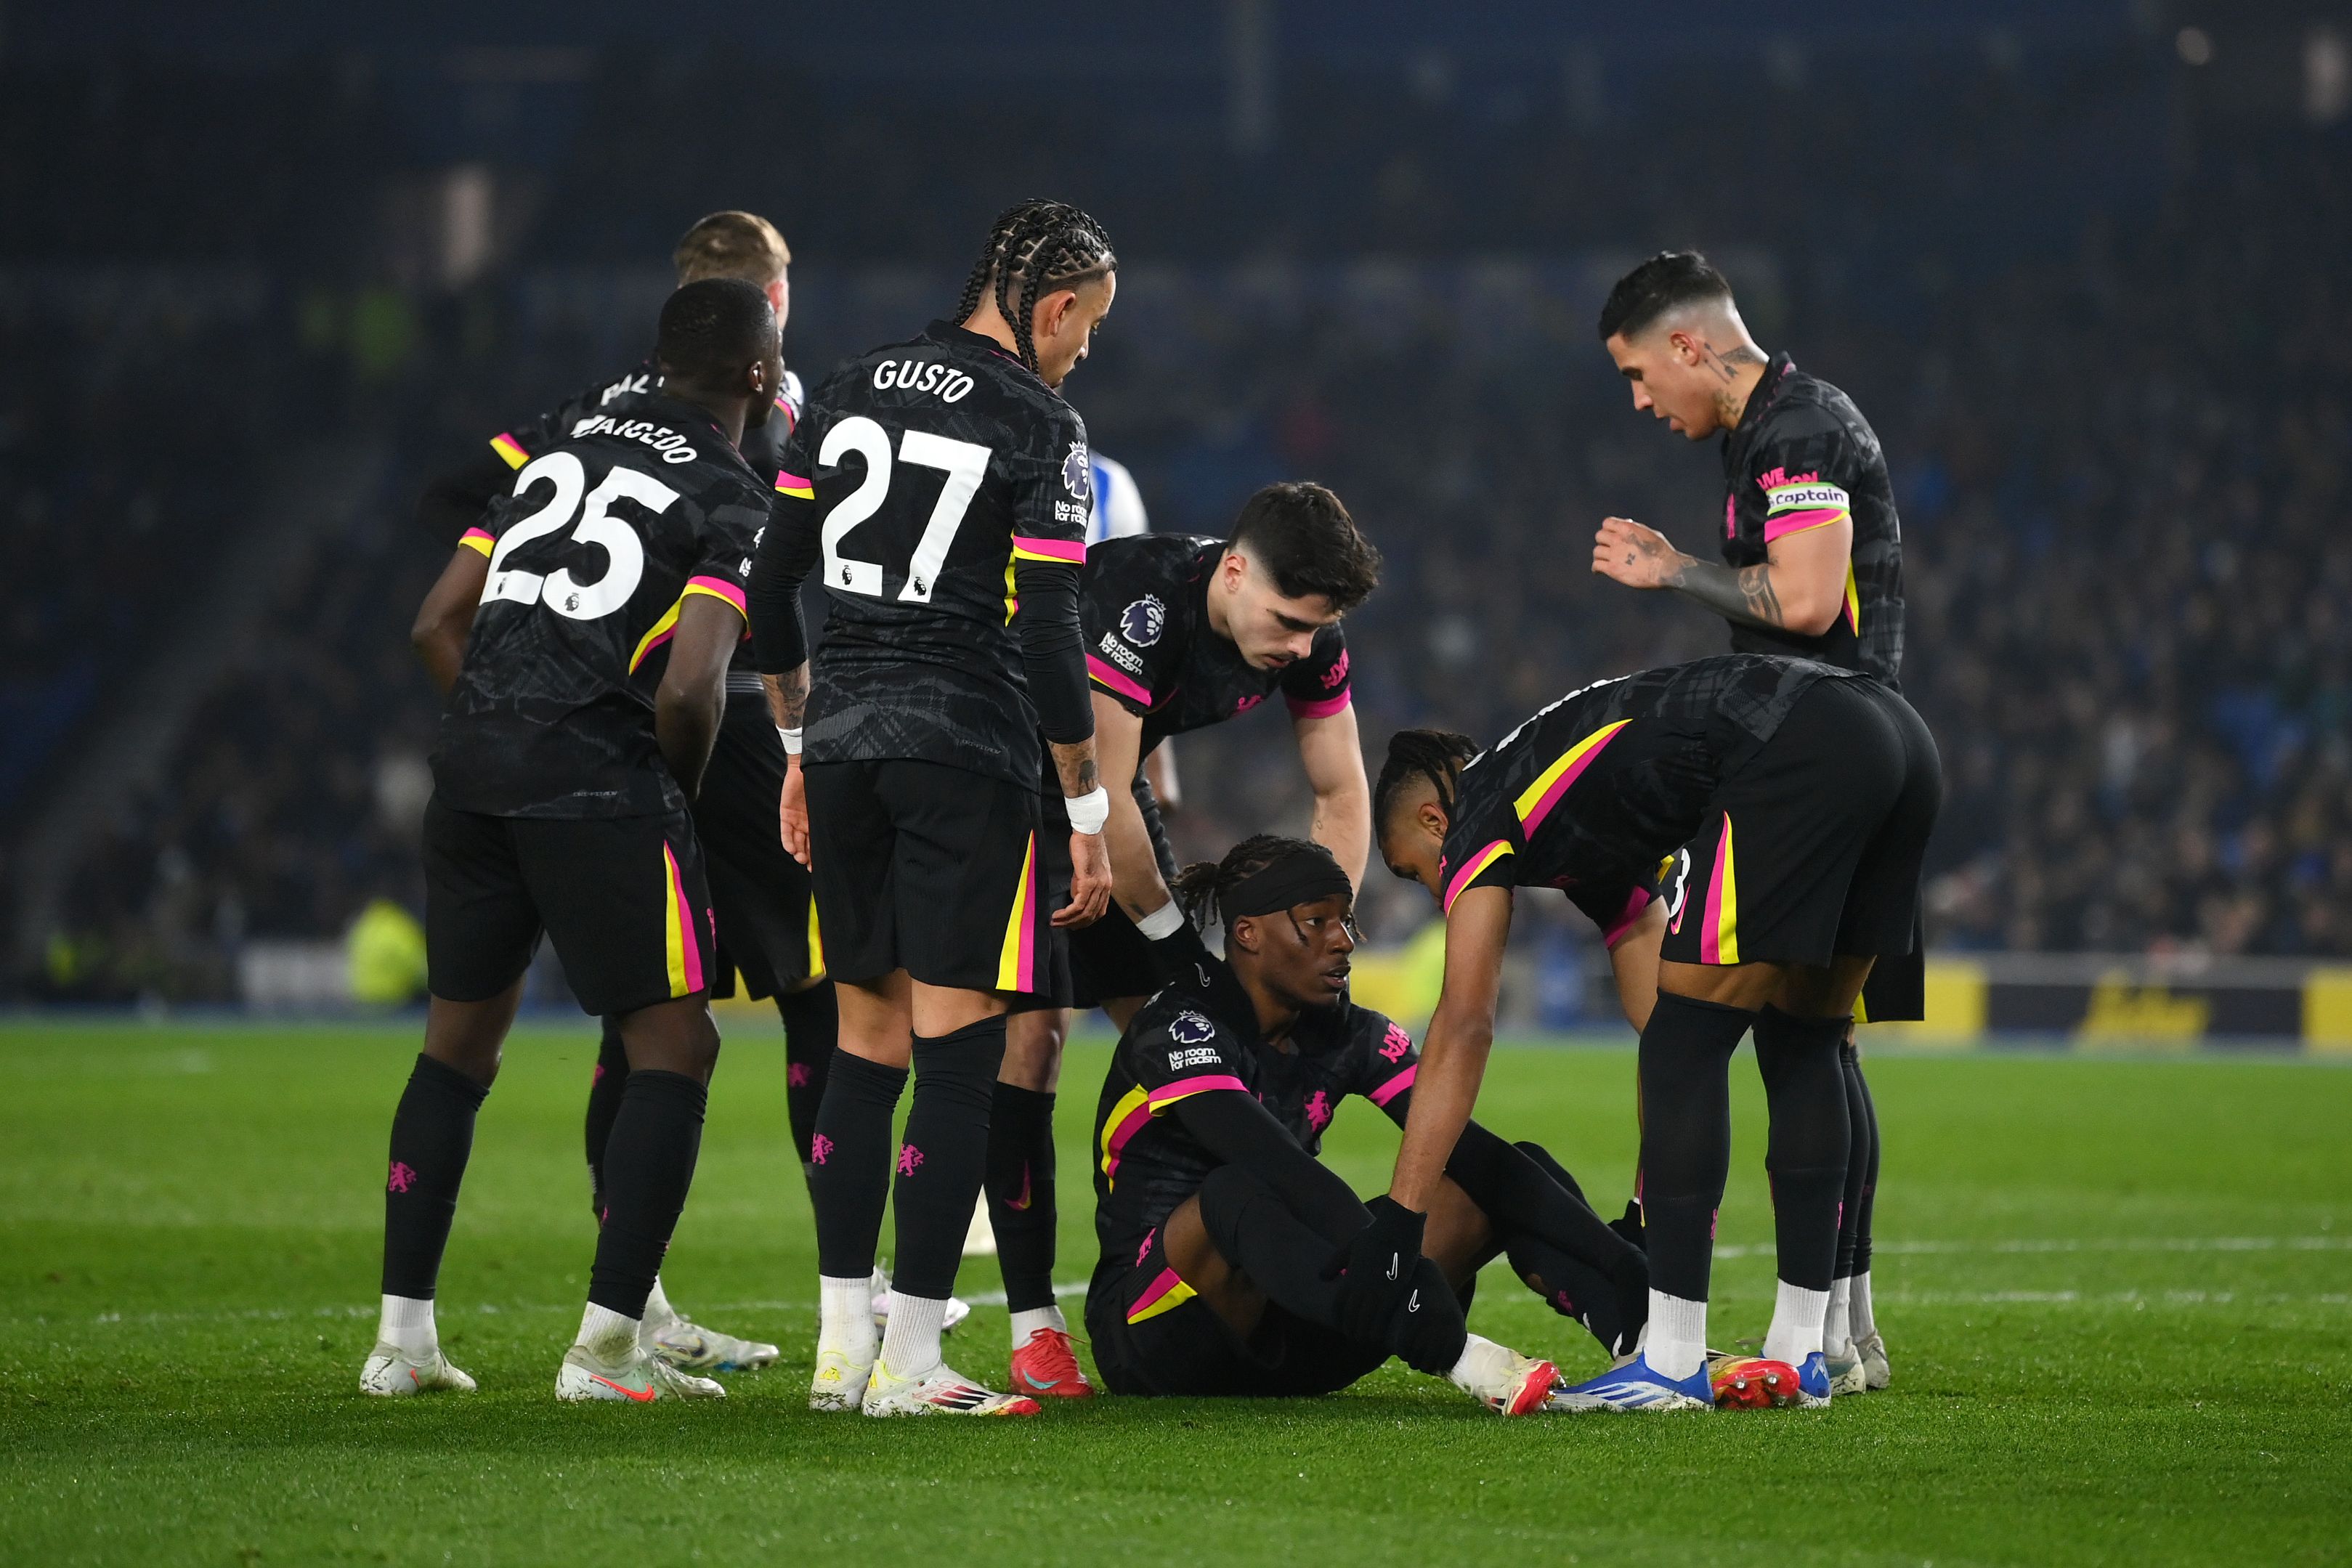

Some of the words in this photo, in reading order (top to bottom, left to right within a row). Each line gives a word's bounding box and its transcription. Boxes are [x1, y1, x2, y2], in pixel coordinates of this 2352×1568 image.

[873, 359, 974, 403] GUSTO
[818, 416, 993, 603] 27
[1055, 500, 1071, 513] No
[1055, 511, 1070, 521] for
[479, 452, 681, 620] 25
[1098, 641, 1114, 654] for
[1111, 651, 1143, 675] racism
[1102, 632, 1118, 648] No
[1116, 644, 1143, 667] room
[1168, 1051, 1184, 1061] No
[1185, 1047, 1216, 1058] room
[1169, 1060, 1184, 1072] for
[1185, 1056, 1222, 1067] racism
